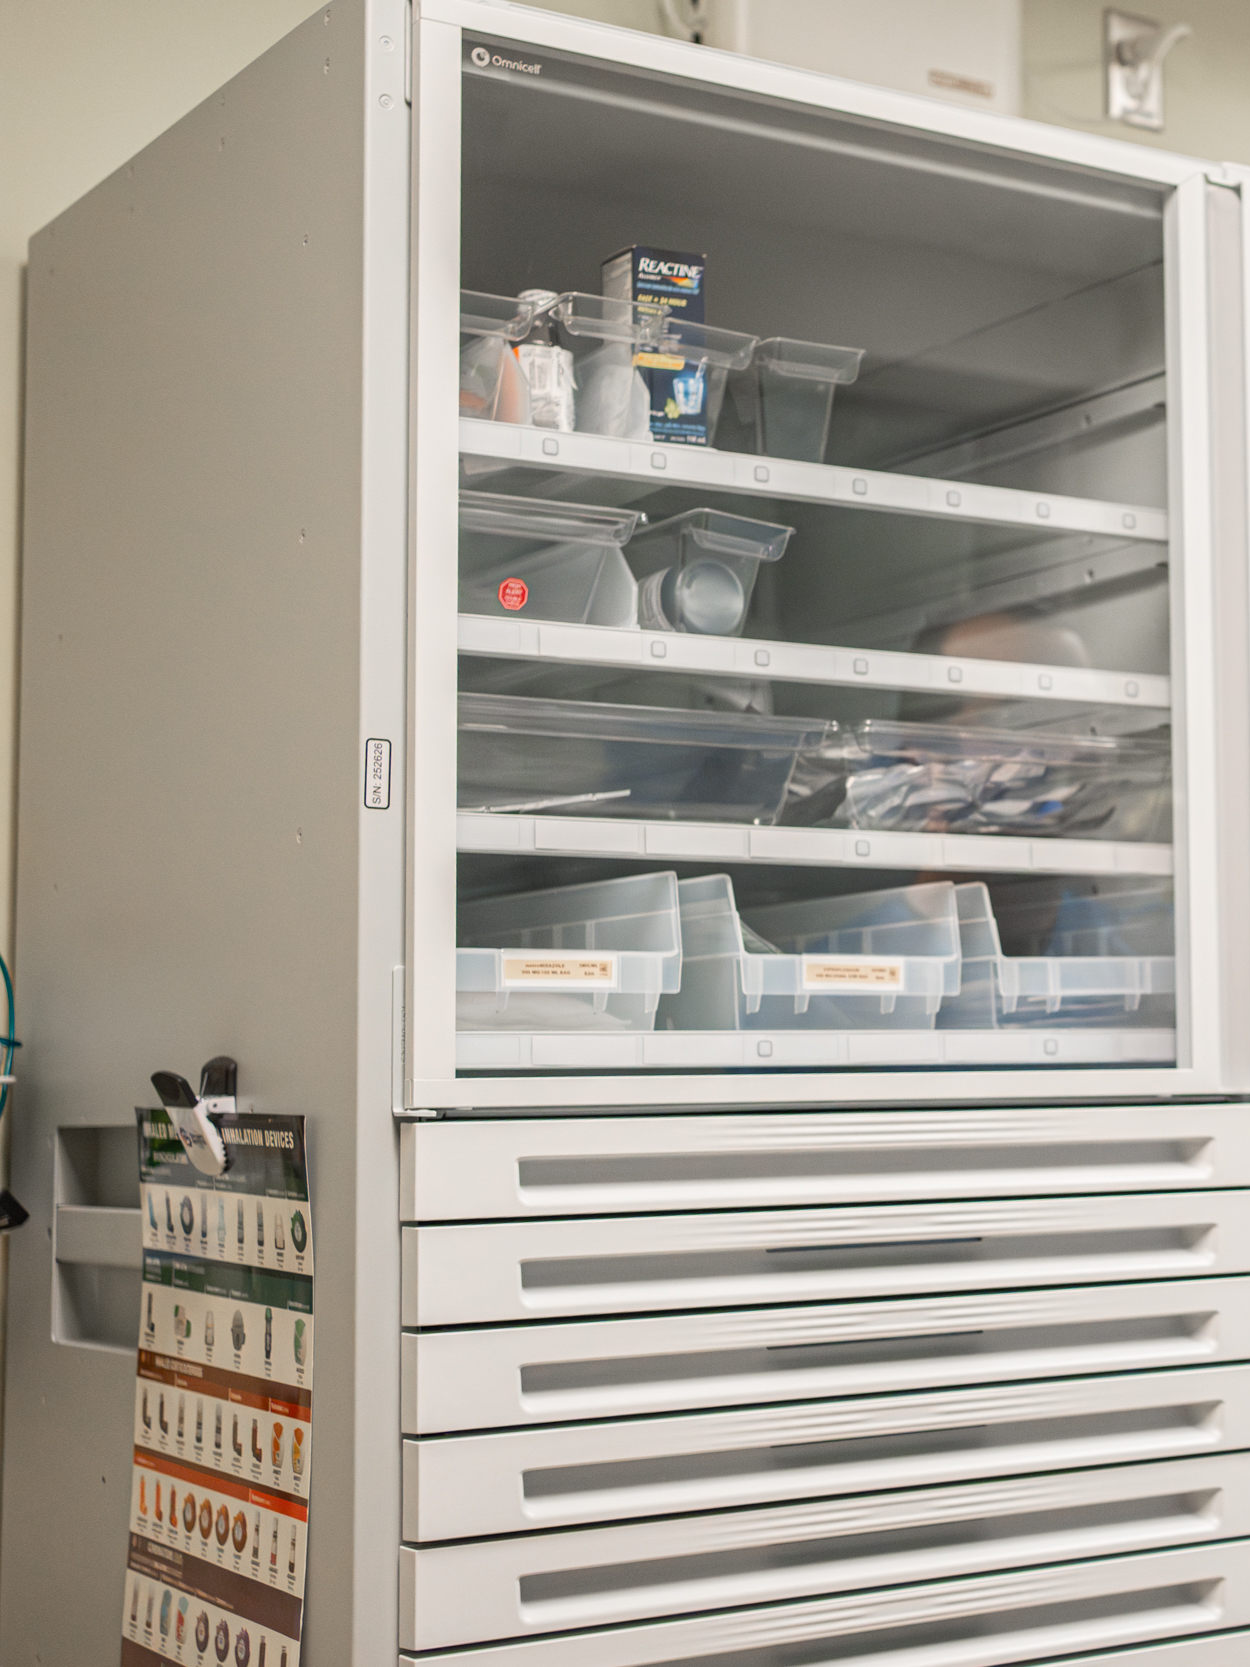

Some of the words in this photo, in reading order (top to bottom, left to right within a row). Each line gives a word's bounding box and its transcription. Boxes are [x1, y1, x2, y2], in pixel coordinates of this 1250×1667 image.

[492, 55, 542, 75] Omnicell
[638, 257, 704, 278] REACTINE
[373, 743, 383, 779] 252626
[372, 783, 381, 804] S/N:
[221, 1127, 264, 1147] INHALATION
[264, 1130, 295, 1150] DEVICES
